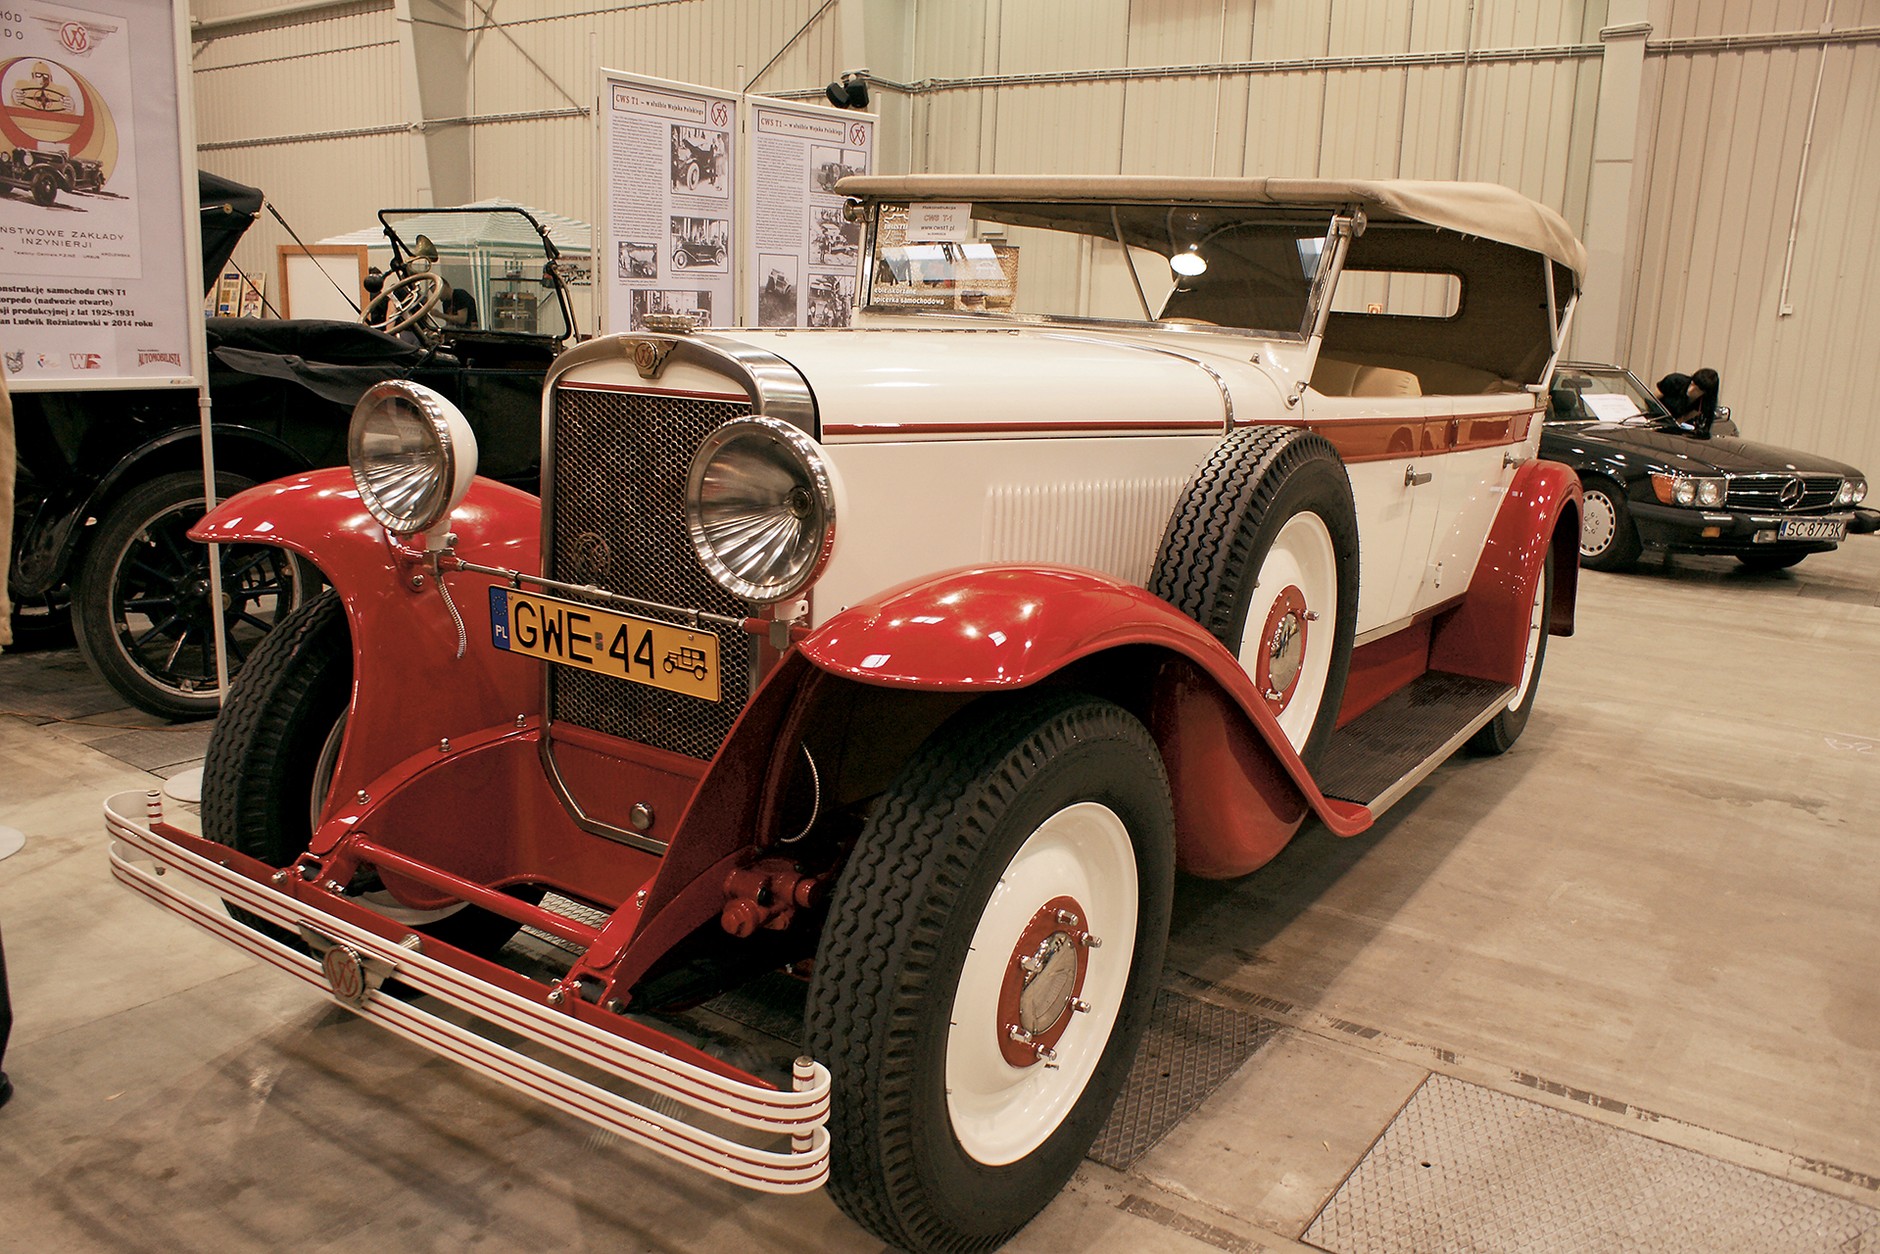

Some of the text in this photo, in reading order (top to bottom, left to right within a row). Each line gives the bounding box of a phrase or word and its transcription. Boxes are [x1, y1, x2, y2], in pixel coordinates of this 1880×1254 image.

[616, 94, 630, 104] CWS
[761, 117, 774, 127] CWS
[71, 231, 125, 241] ZAKŁADY
[46, 287, 95, 295] samochodu
[97, 288, 114, 296] CWS
[12, 307, 69, 317] produkcyjnej
[91, 309, 135, 317] 1928-1931
[13, 318, 44, 326] Ludwik
[134, 320, 153, 328] roku
[1787, 522, 1844, 537] SC 8773K
[495, 624, 508, 639] PL
[514, 600, 655, 679] GWE 44
